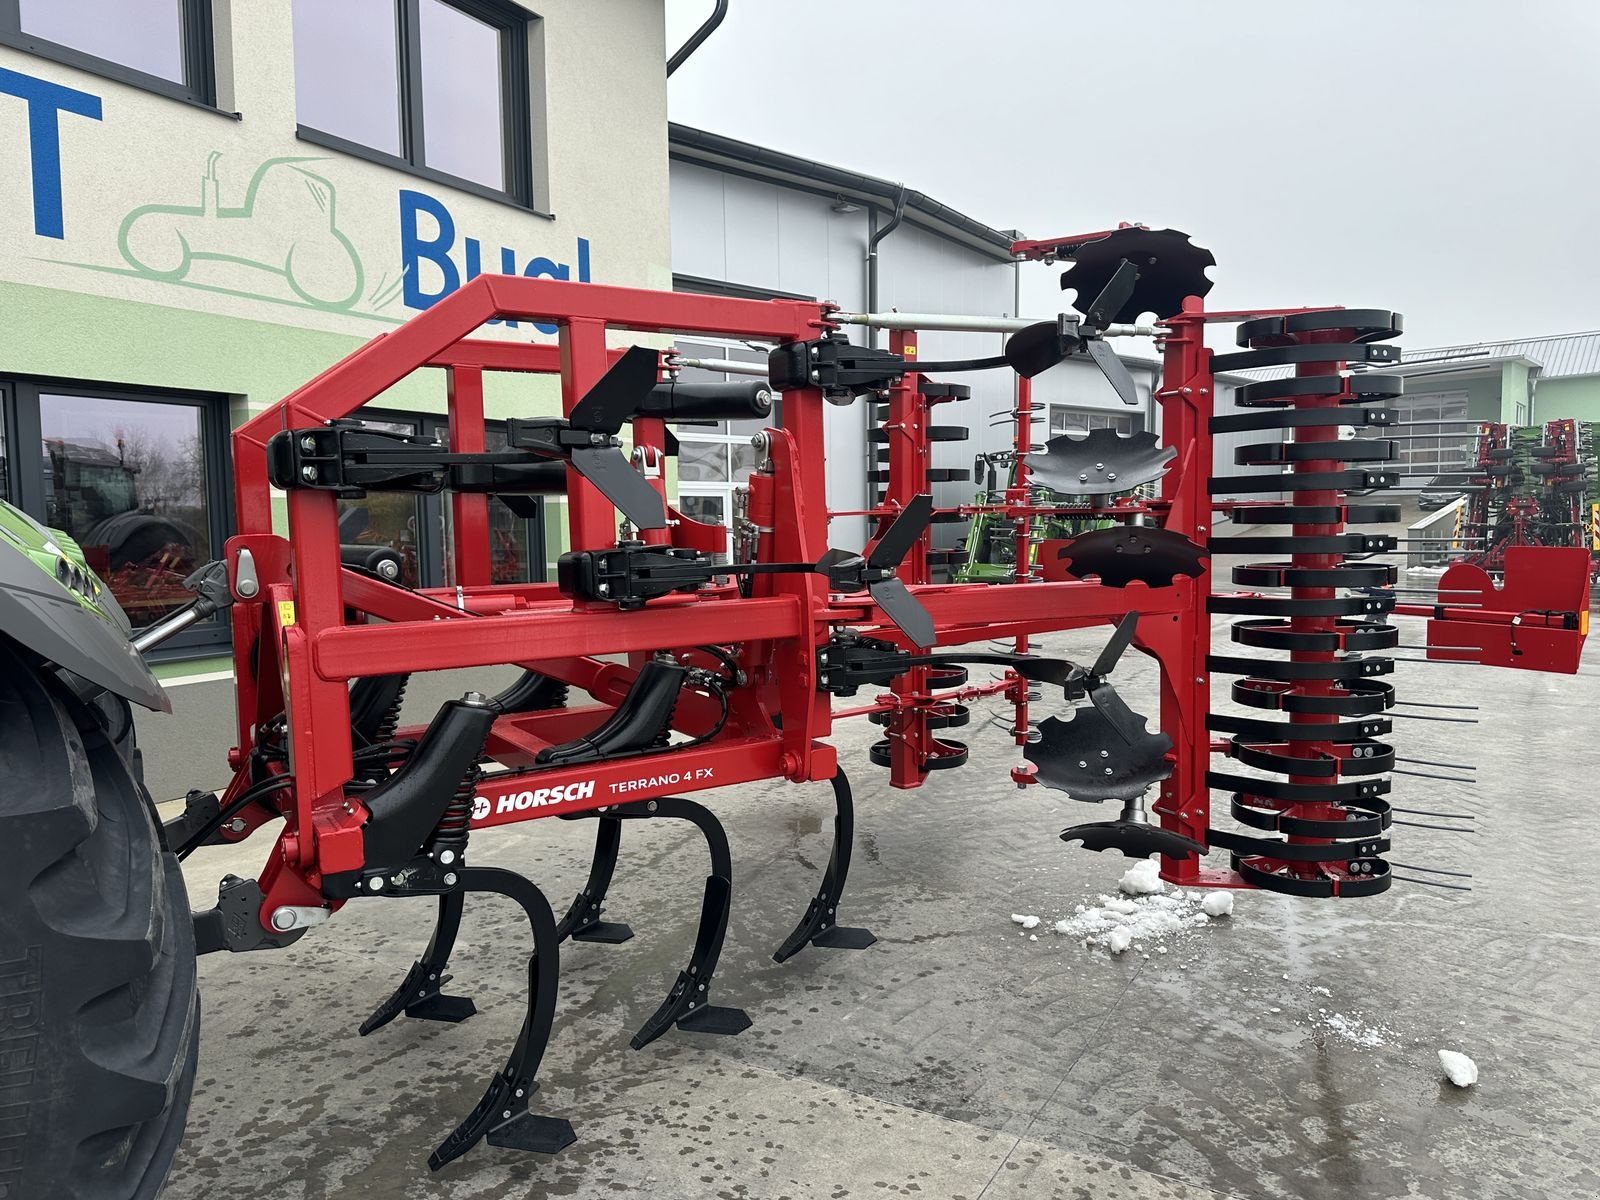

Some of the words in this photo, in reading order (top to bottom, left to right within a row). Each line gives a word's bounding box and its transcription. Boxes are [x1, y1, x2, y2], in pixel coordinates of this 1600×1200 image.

[495, 780, 596, 814] HORSCH
[609, 773, 680, 794] TERRANO
[683, 771, 692, 781] 4
[695, 767, 714, 780] FX
